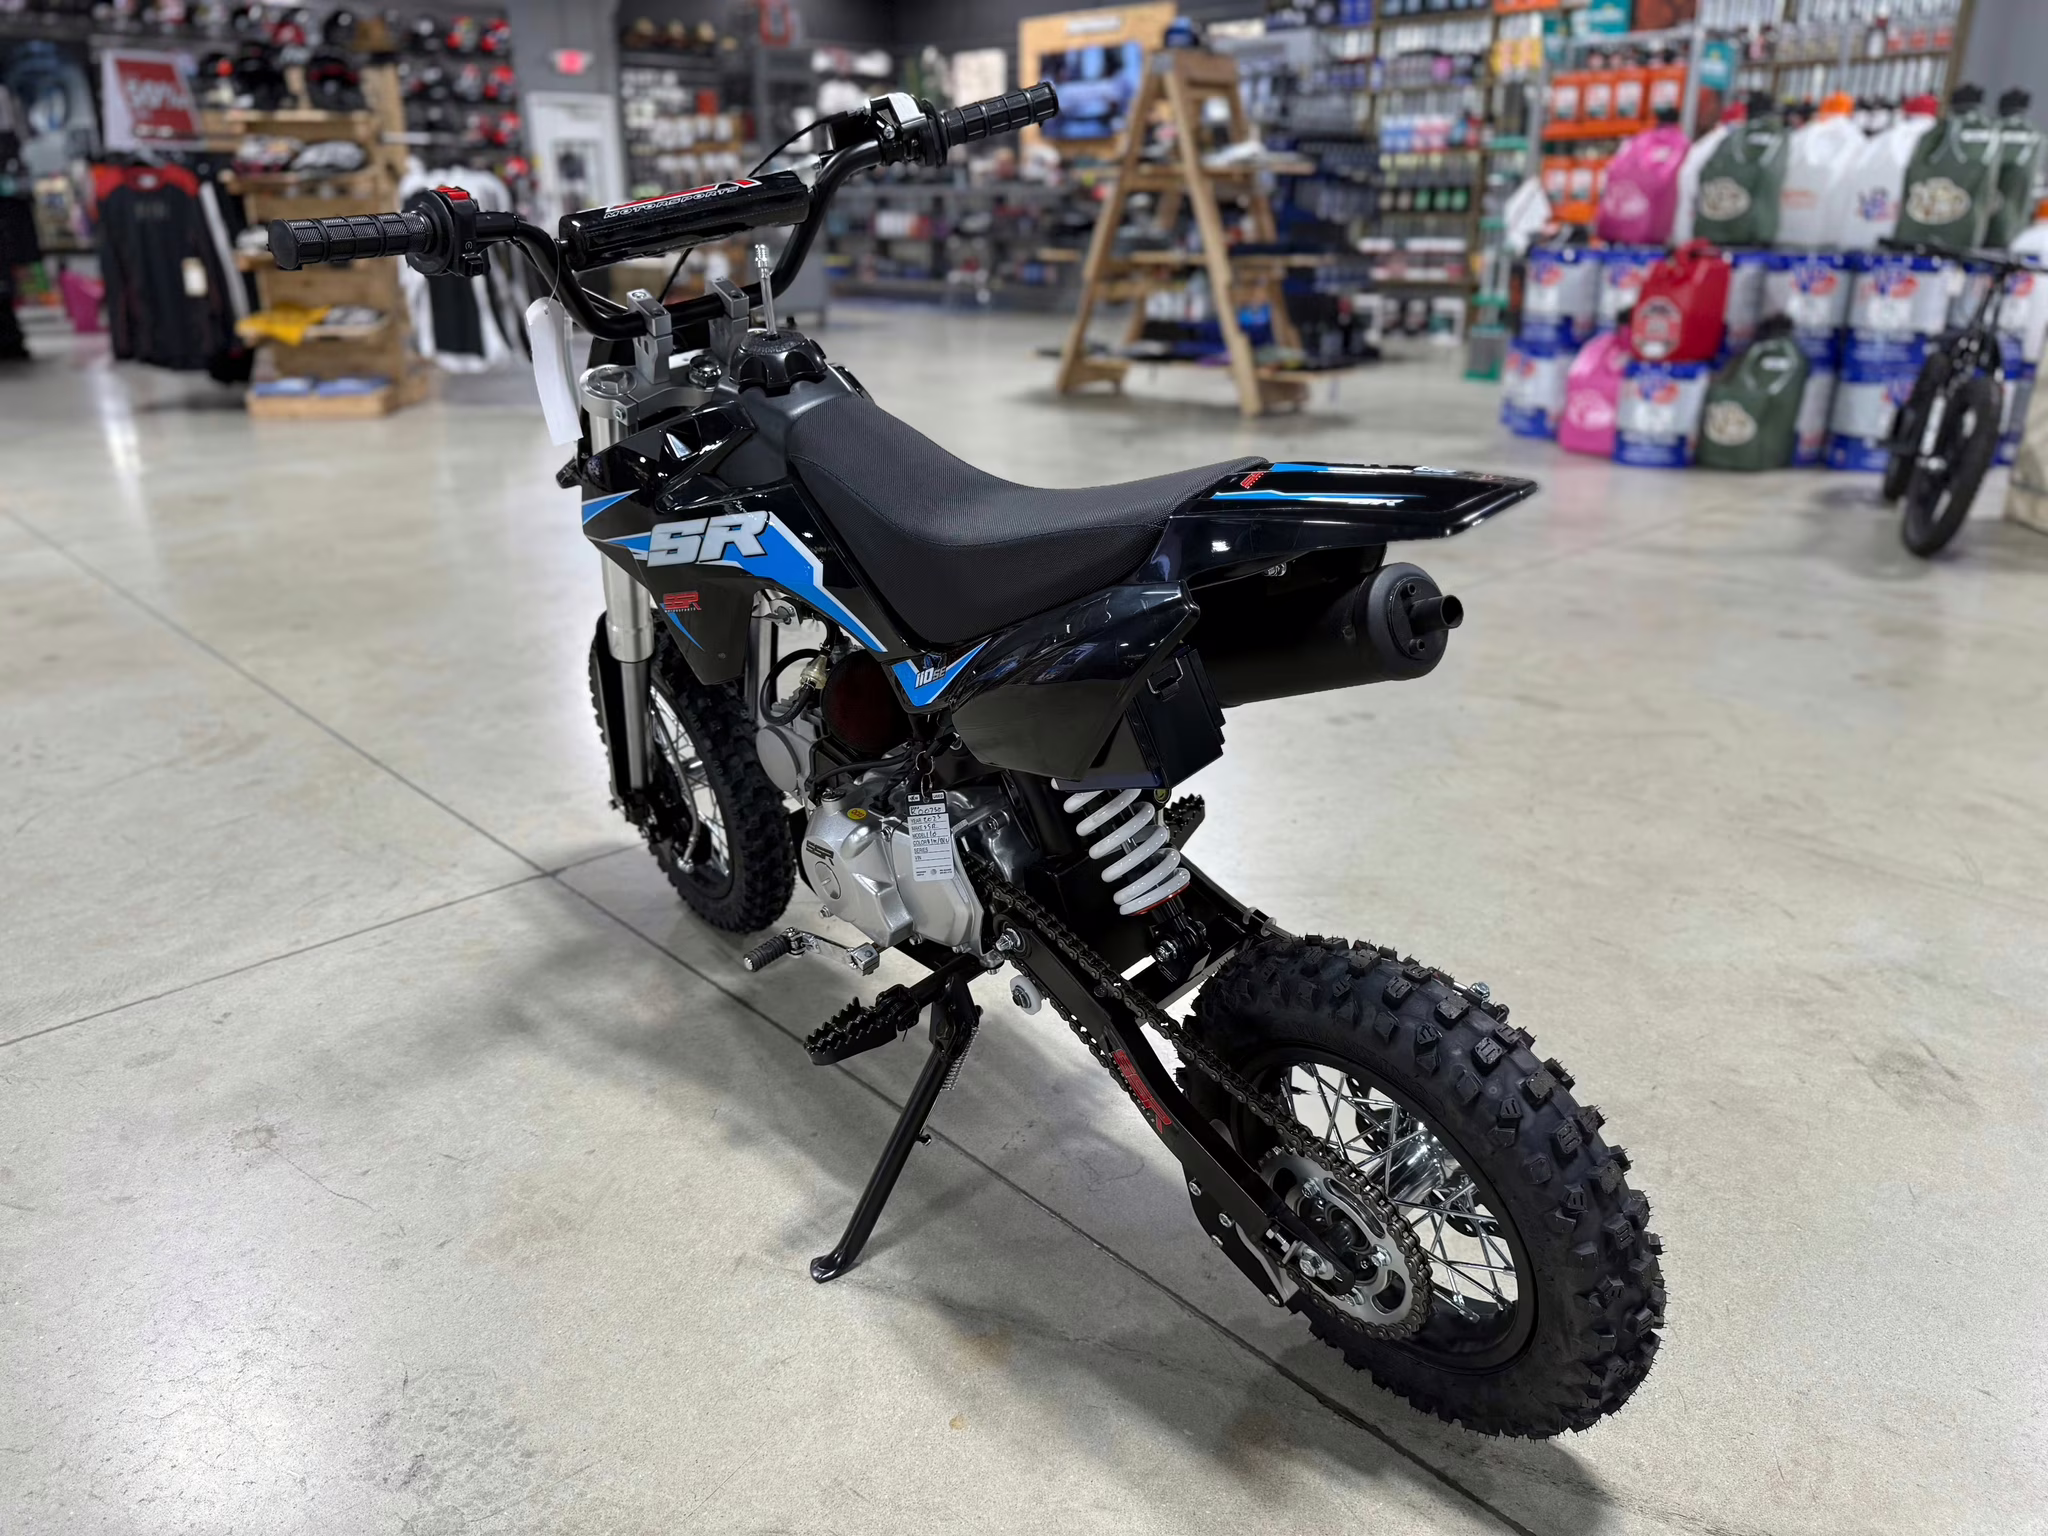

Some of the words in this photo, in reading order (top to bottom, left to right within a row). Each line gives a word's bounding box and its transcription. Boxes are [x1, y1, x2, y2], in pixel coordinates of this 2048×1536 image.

[603, 185, 739, 219] MOTORSPORTS
[647, 510, 768, 567] SR
[664, 592, 702, 611] SSR
[806, 840, 834, 866] SSR
[1112, 1049, 1172, 1134] SSR
